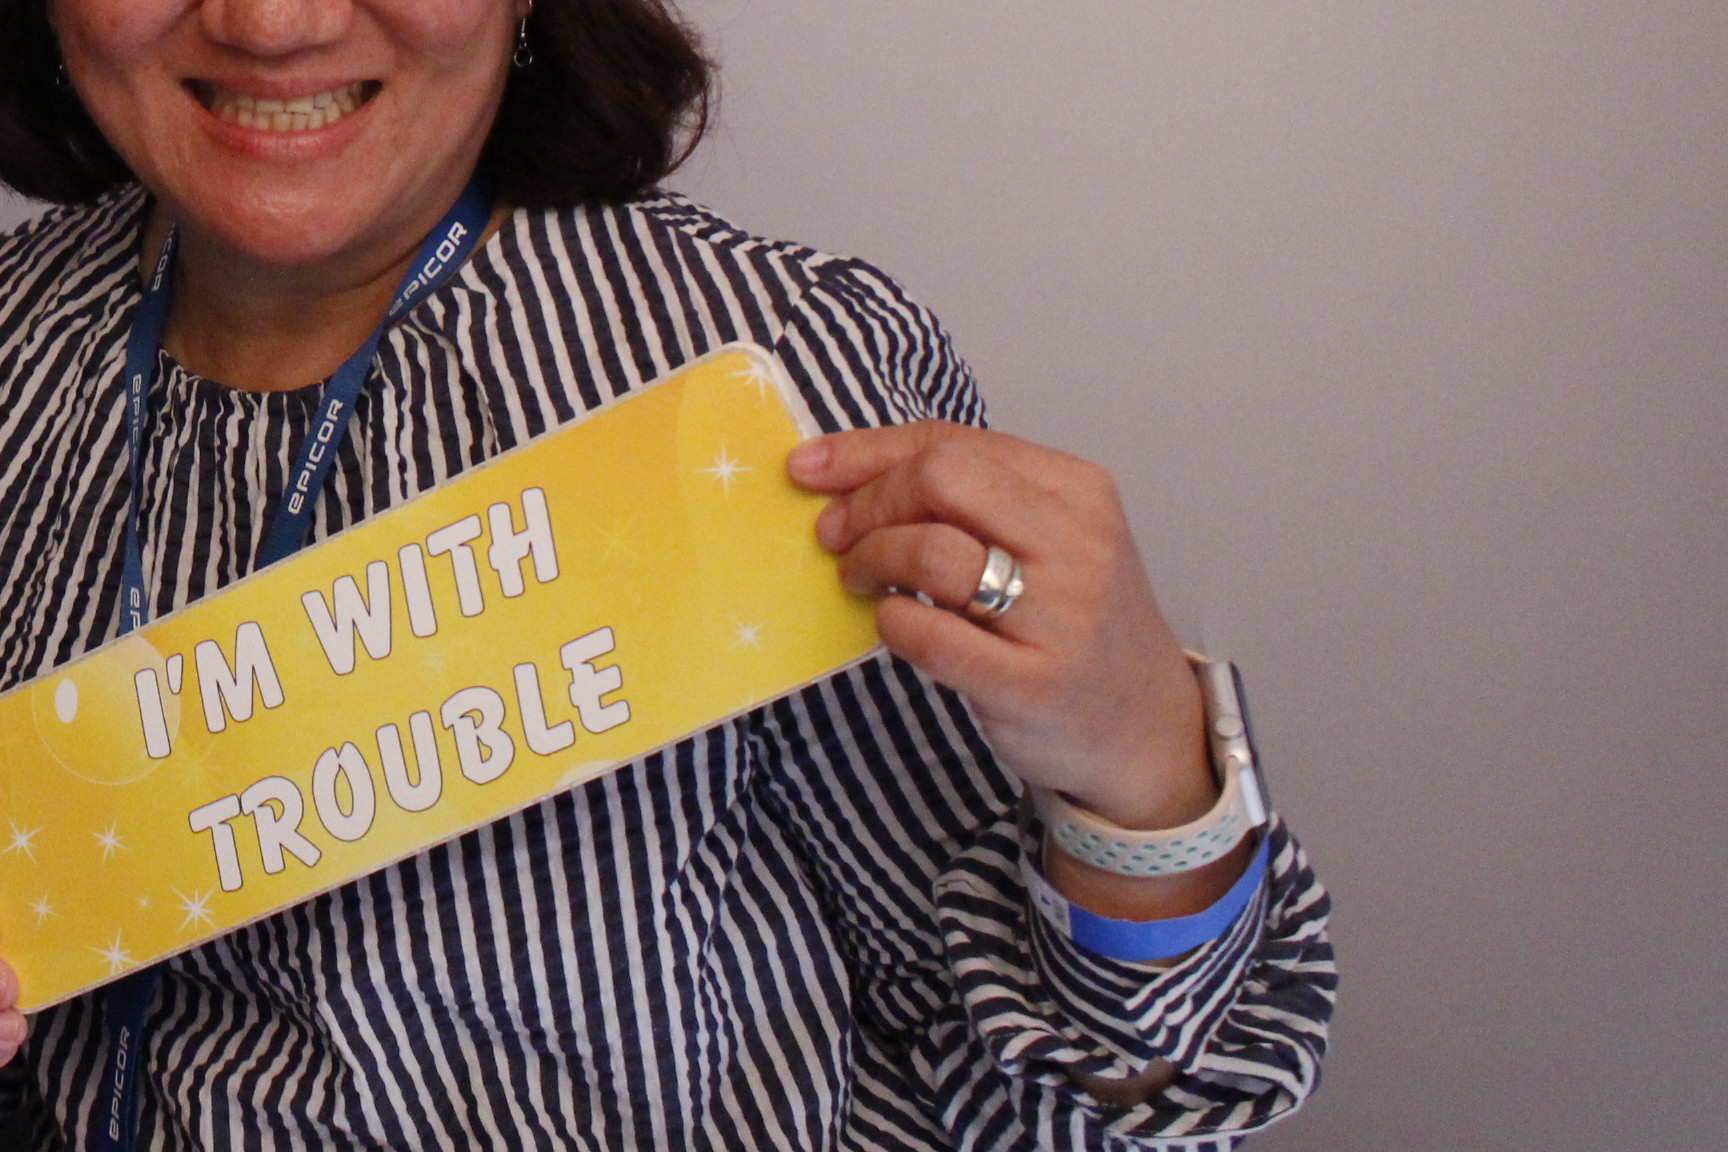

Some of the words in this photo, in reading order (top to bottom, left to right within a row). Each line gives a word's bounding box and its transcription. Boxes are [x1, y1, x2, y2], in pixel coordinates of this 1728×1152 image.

[134, 621, 285, 759] I'M
[301, 486, 560, 676] WITH
[188, 625, 632, 892] TROUBLE
